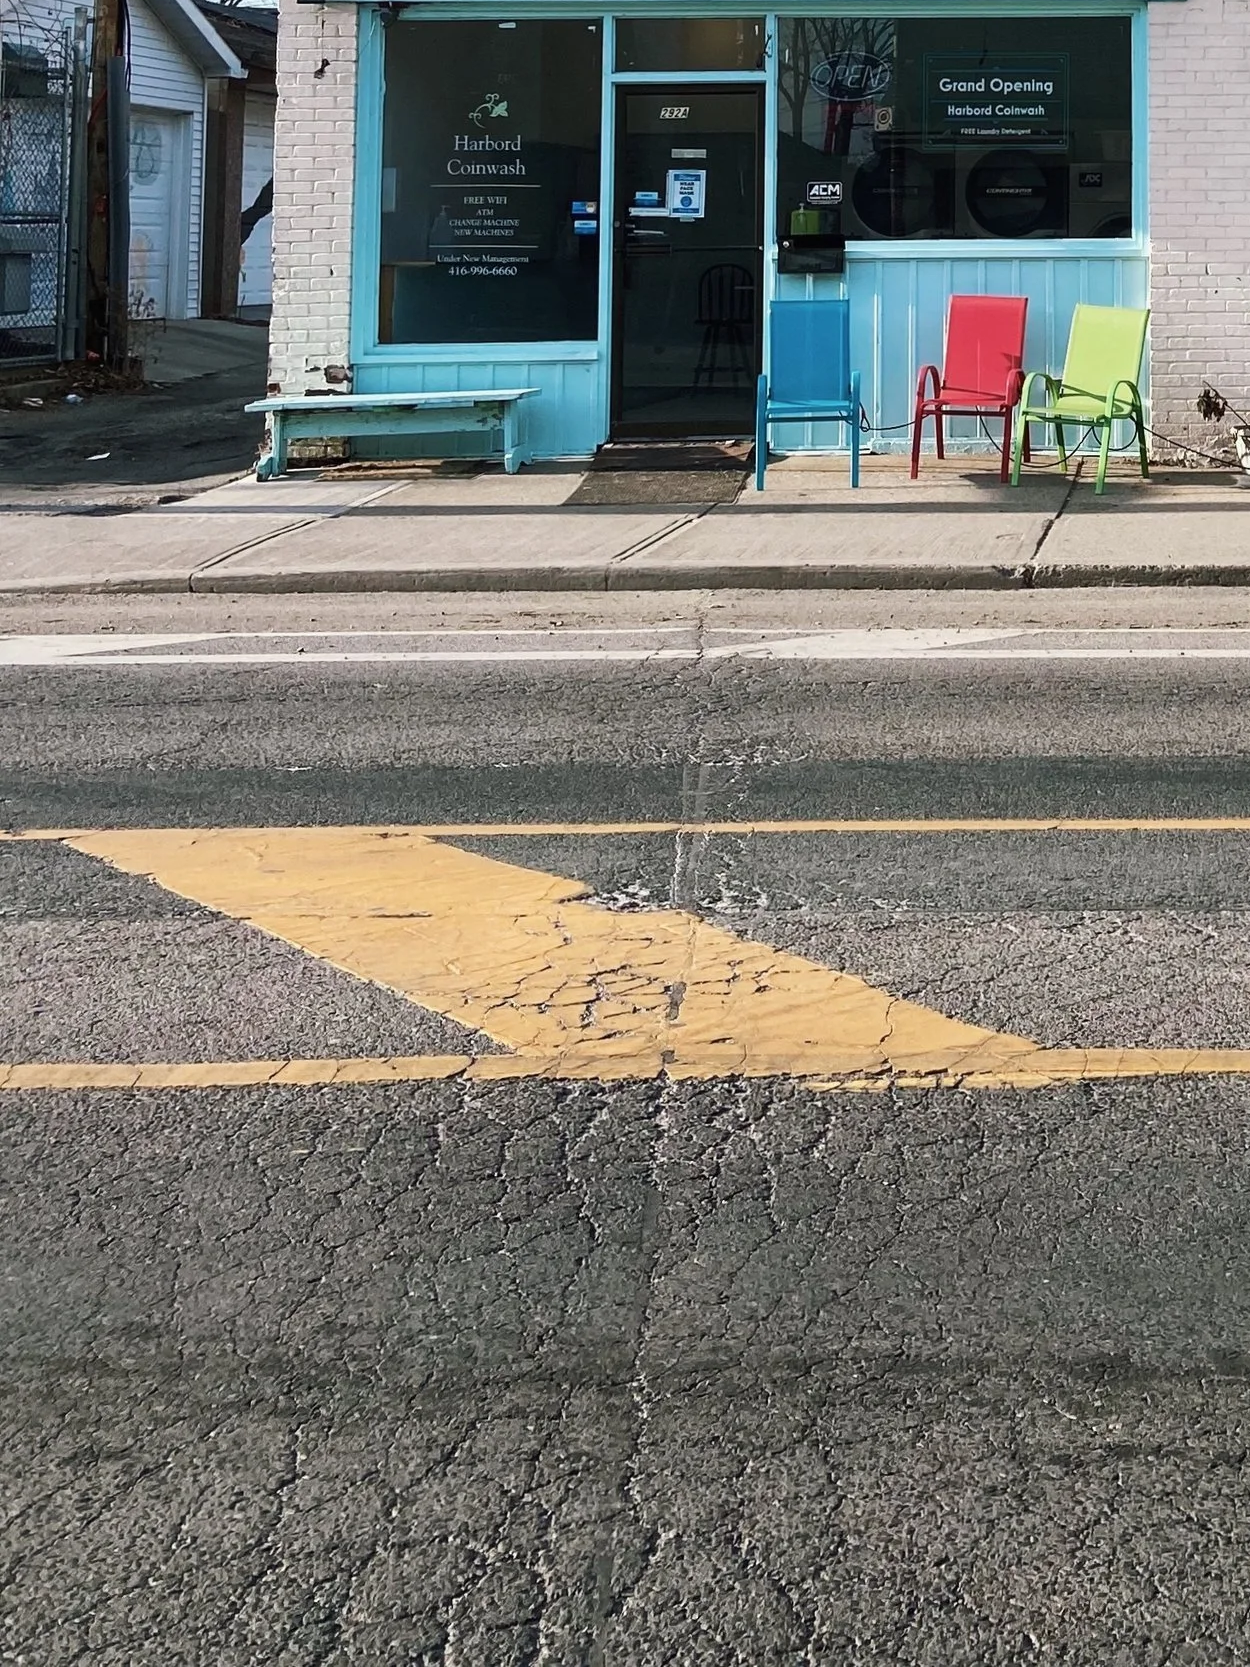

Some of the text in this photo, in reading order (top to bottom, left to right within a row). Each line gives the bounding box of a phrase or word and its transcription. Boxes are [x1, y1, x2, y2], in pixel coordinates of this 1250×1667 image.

[816, 65, 882, 88] OPEN
[939, 78, 1053, 95] Grand Opening
[661, 108, 688, 118] 292A
[947, 105, 1045, 115] Harbord Coinwash
[454, 135, 521, 151] Harbord
[447, 159, 526, 175] Coinwash
[810, 184, 840, 195] ACM
[464, 196, 507, 204] FREE WIFI
[437, 254, 529, 263] Under New Management
[448, 266, 518, 275] 416-996-6660
